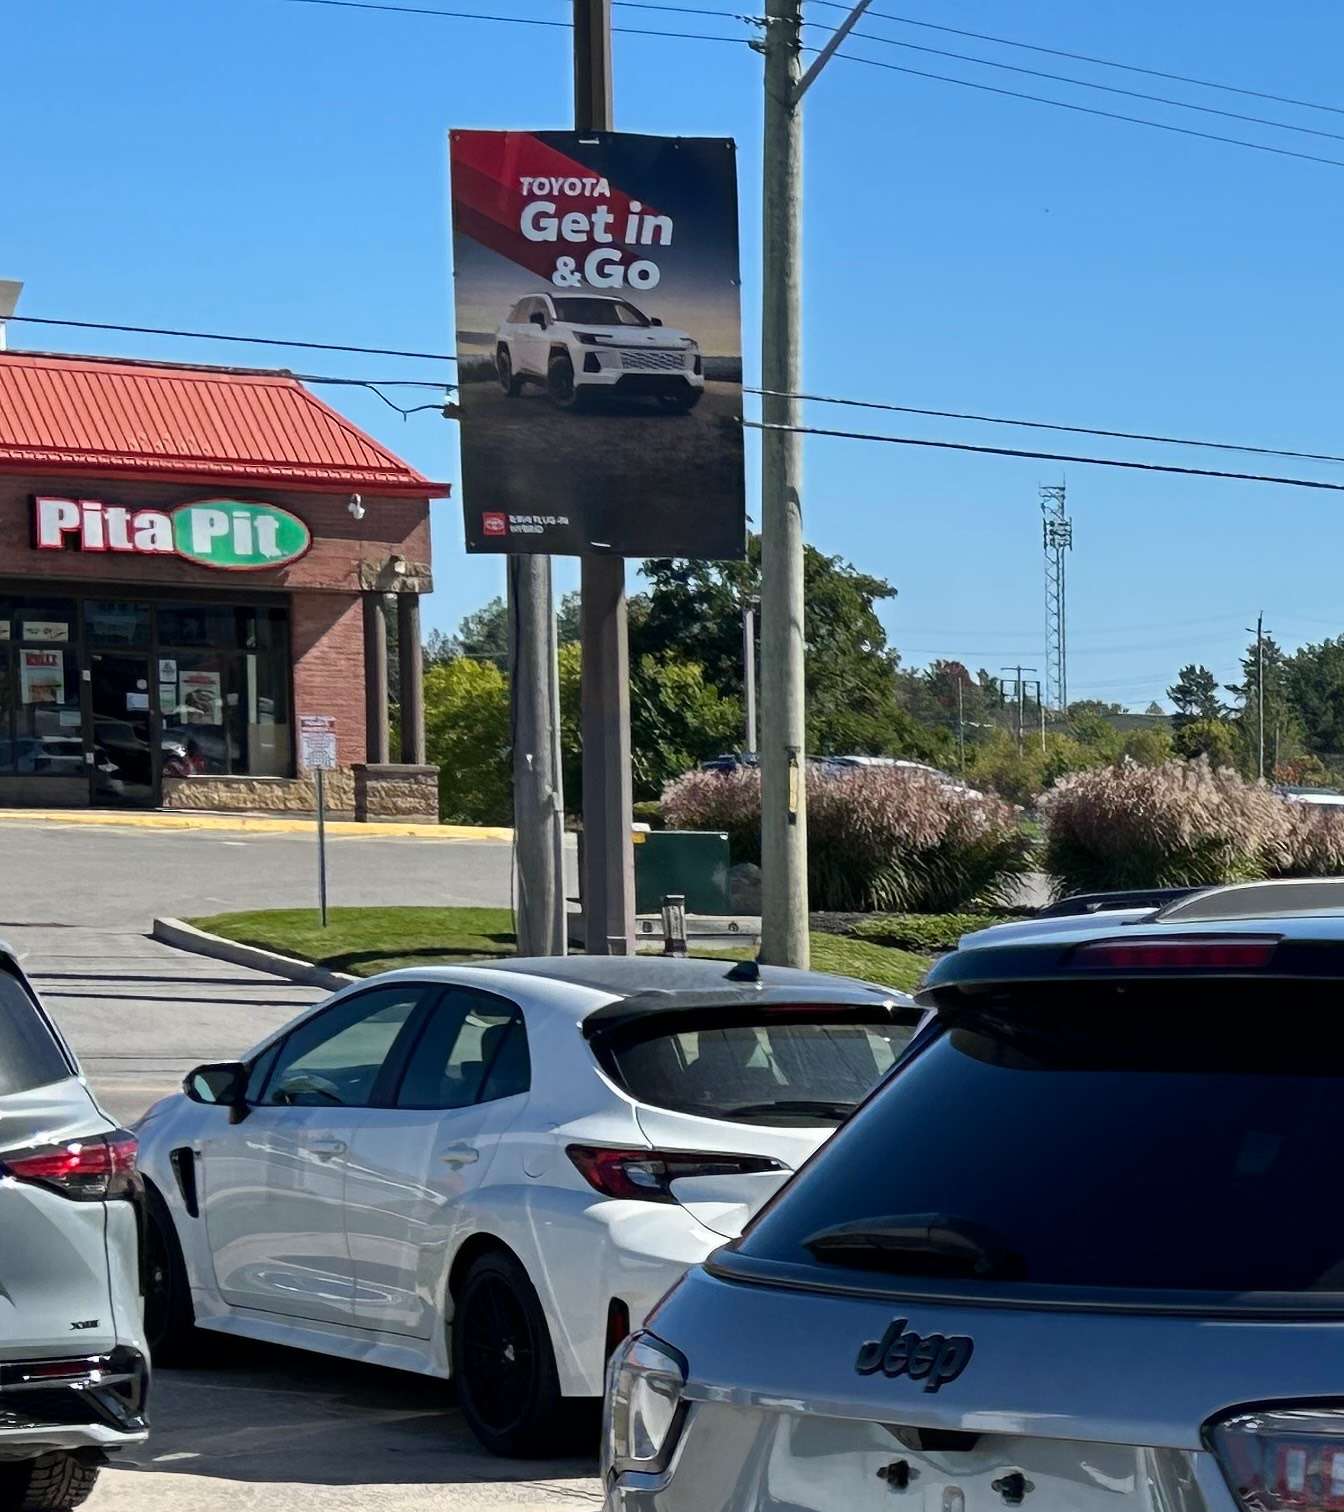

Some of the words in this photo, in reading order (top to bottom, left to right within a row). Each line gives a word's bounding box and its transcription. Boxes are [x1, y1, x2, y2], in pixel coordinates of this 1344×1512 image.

[519, 176, 611, 198] TOYOTA
[520, 200, 614, 244] Get
[624, 200, 674, 246] in
[37, 498, 175, 553] Pita
[191, 507, 283, 559] Pit
[855, 1316, 975, 1393] Jeep
